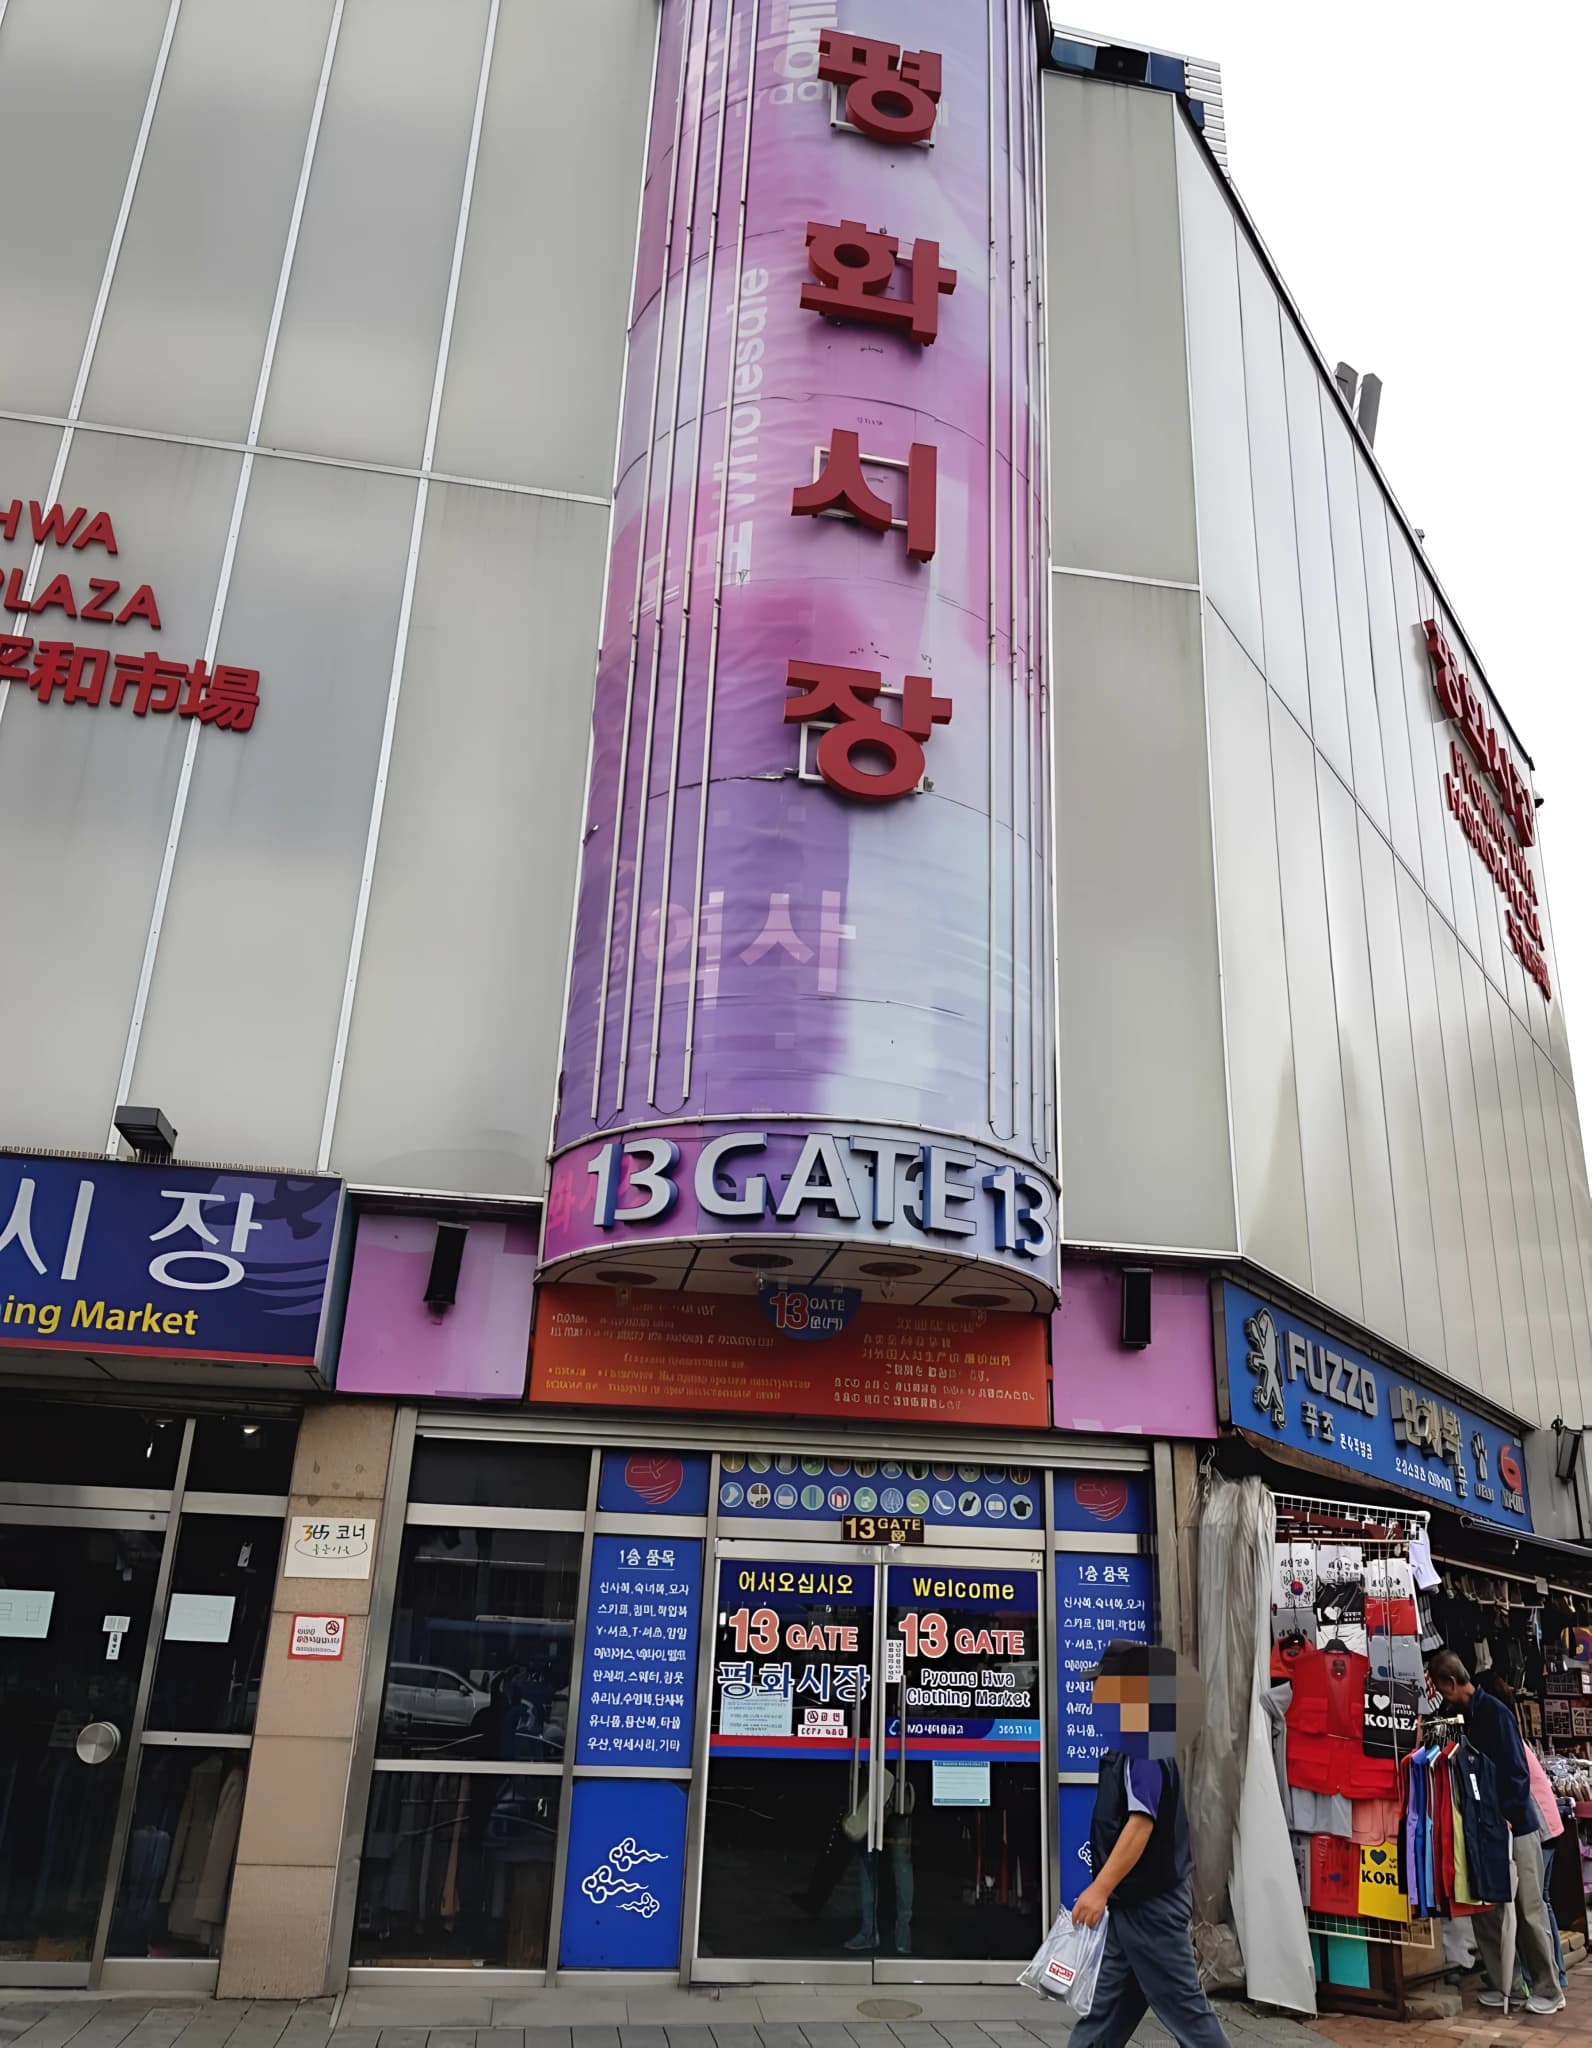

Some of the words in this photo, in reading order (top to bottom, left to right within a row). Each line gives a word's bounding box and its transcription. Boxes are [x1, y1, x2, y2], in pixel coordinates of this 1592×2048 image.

[784, 29, 957, 800] 평화시장
[0, 567, 161, 630] LAZA
[587, 1137, 681, 1229] 13
[695, 1132, 978, 1237] GATE
[982, 1165, 1054, 1259] 13
[0, 1295, 61, 1334] ing
[71, 1300, 199, 1336] Market
[770, 1291, 810, 1330] 13
[1285, 1330, 1379, 1417] FUZZO
[1302, 1401, 1336, 1442] 푸조
[302, 1524, 330, 1541] 365
[336, 1524, 366, 1540] 코너
[845, 1516, 876, 1540] 13
[878, 1517, 921, 1531] GATE
[739, 1571, 853, 1595] 어서오십시오
[912, 1577, 1015, 1600] Welcome
[729, 1608, 780, 1655] 13
[786, 1624, 858, 1652] GATE
[899, 1613, 949, 1659] 13
[954, 1628, 1025, 1655] GATE
[718, 1661, 870, 1702] 평화시장
[921, 1668, 979, 1687] Pyoung
[974, 1689, 1031, 1708] Market
